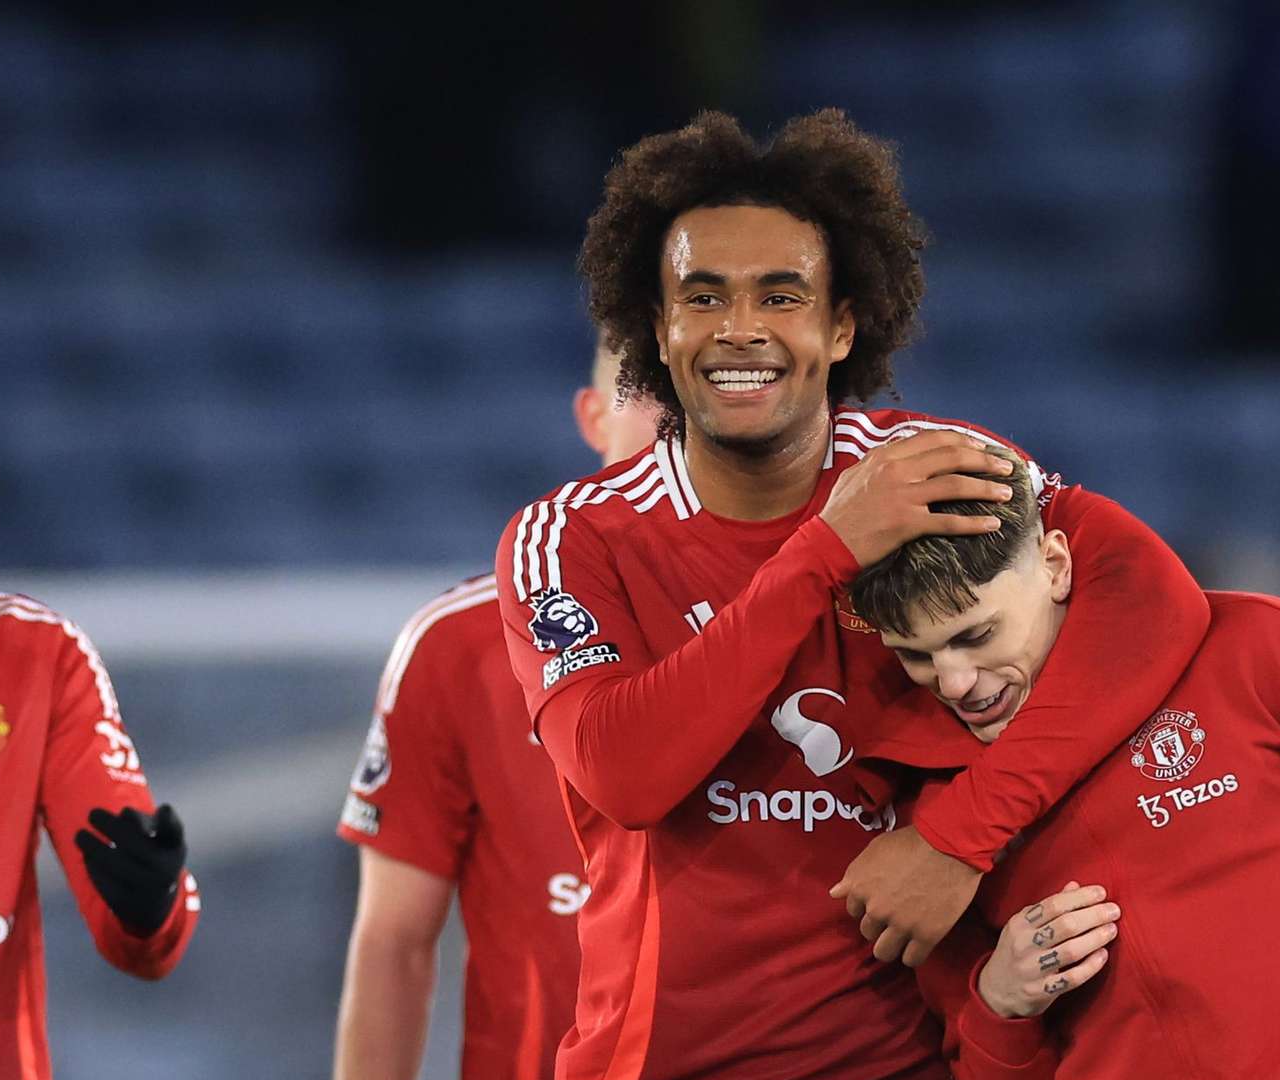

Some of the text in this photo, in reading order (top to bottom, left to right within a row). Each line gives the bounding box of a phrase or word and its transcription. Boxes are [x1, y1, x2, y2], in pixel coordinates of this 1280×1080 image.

[562, 645, 610, 664] room
[563, 653, 620, 676] racism
[1155, 755, 1196, 778] UNITED
[1165, 774, 1239, 811] Tezos
